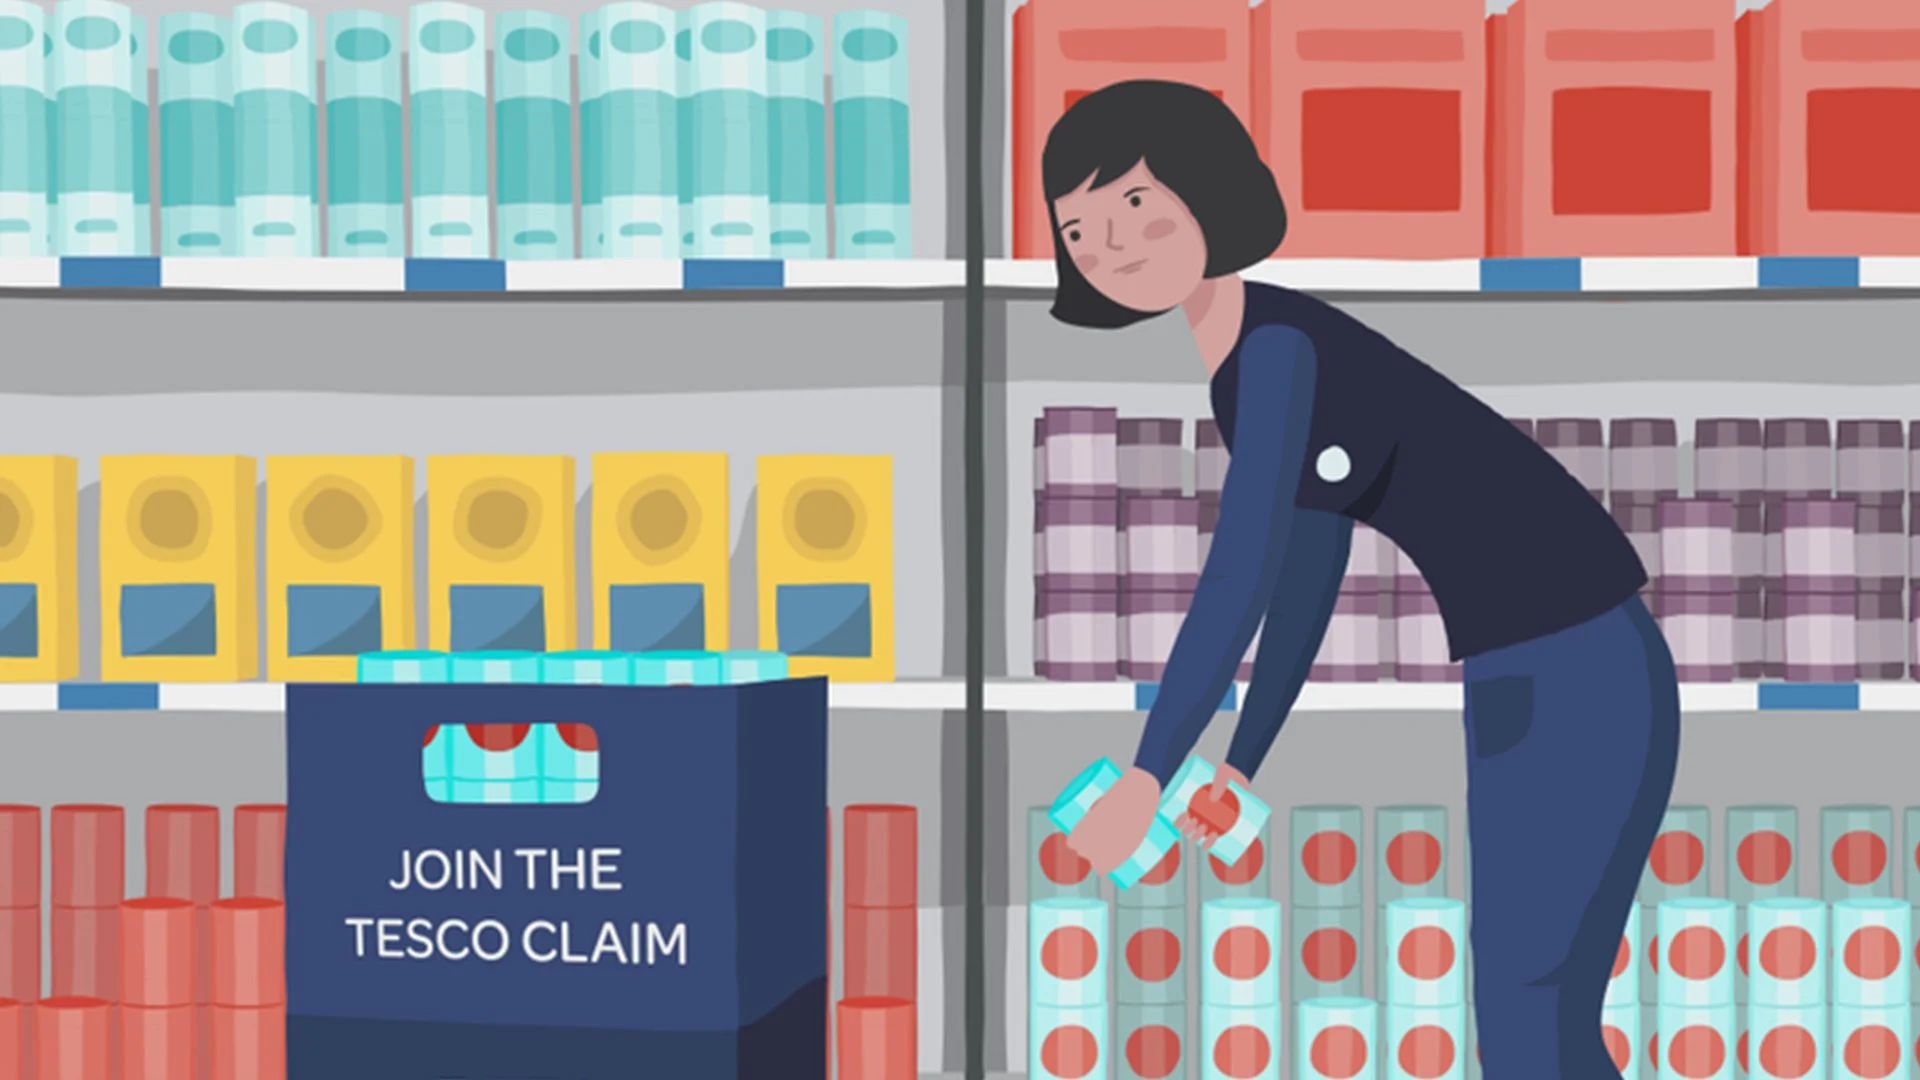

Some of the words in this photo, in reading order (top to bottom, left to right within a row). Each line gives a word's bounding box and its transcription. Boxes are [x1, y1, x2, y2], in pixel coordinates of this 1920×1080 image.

[389, 848, 502, 890] JOIN
[514, 848, 622, 890] THE
[345, 918, 510, 961] TESCO
[522, 920, 687, 965] CLAIM
